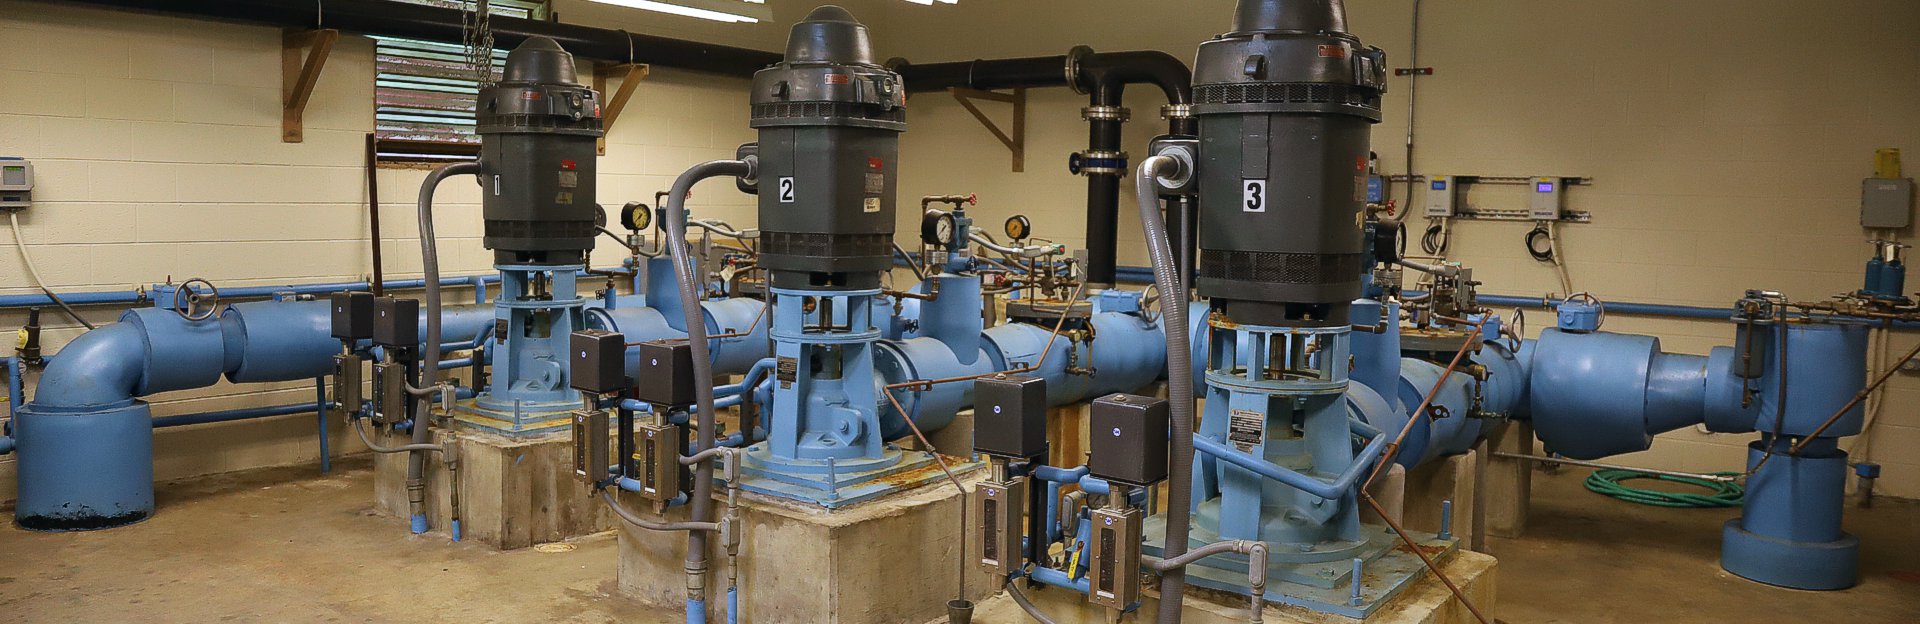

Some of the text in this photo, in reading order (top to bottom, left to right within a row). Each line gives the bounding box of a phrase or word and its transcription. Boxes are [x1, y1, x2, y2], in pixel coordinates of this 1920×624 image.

[495, 176, 499, 194] 1
[781, 179, 792, 200] 2
[1246, 182, 1262, 209] 3
